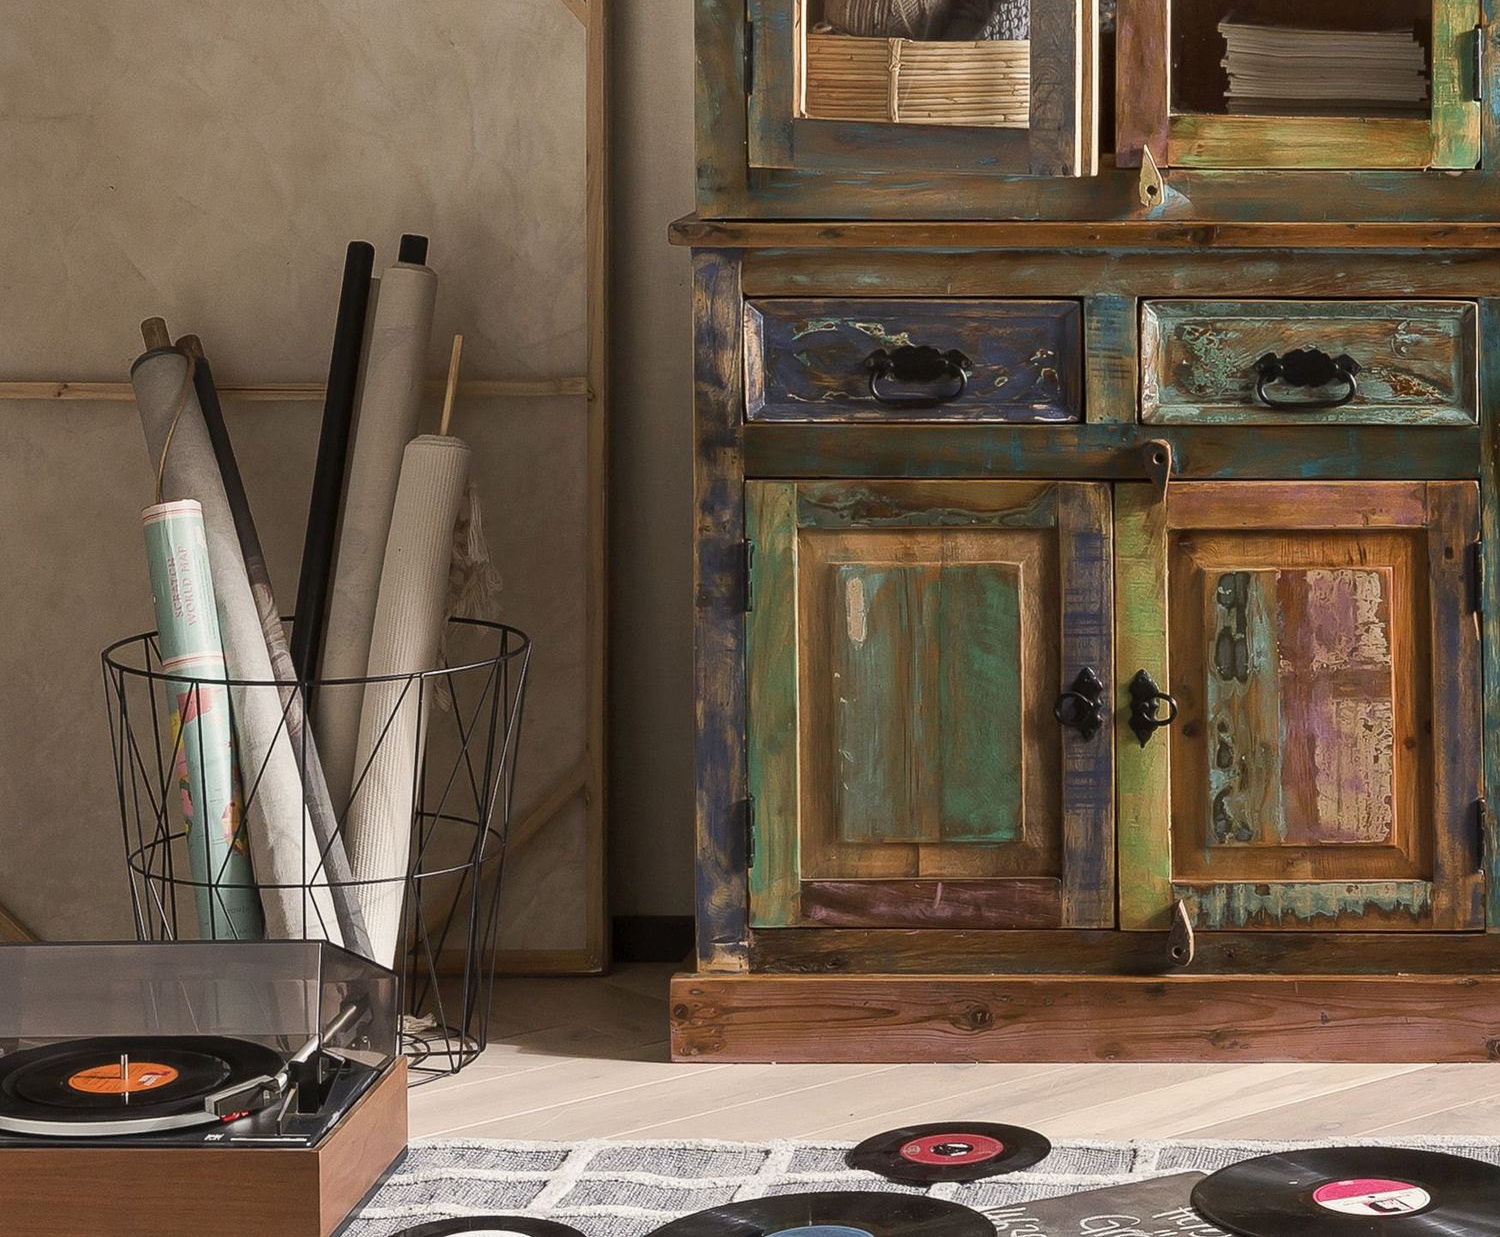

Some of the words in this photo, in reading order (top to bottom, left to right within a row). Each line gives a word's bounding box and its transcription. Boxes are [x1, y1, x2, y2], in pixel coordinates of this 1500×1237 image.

[177, 545, 190, 572] MAP
[167, 556, 183, 618] SCRATCH
[182, 578, 197, 626] WORLD
